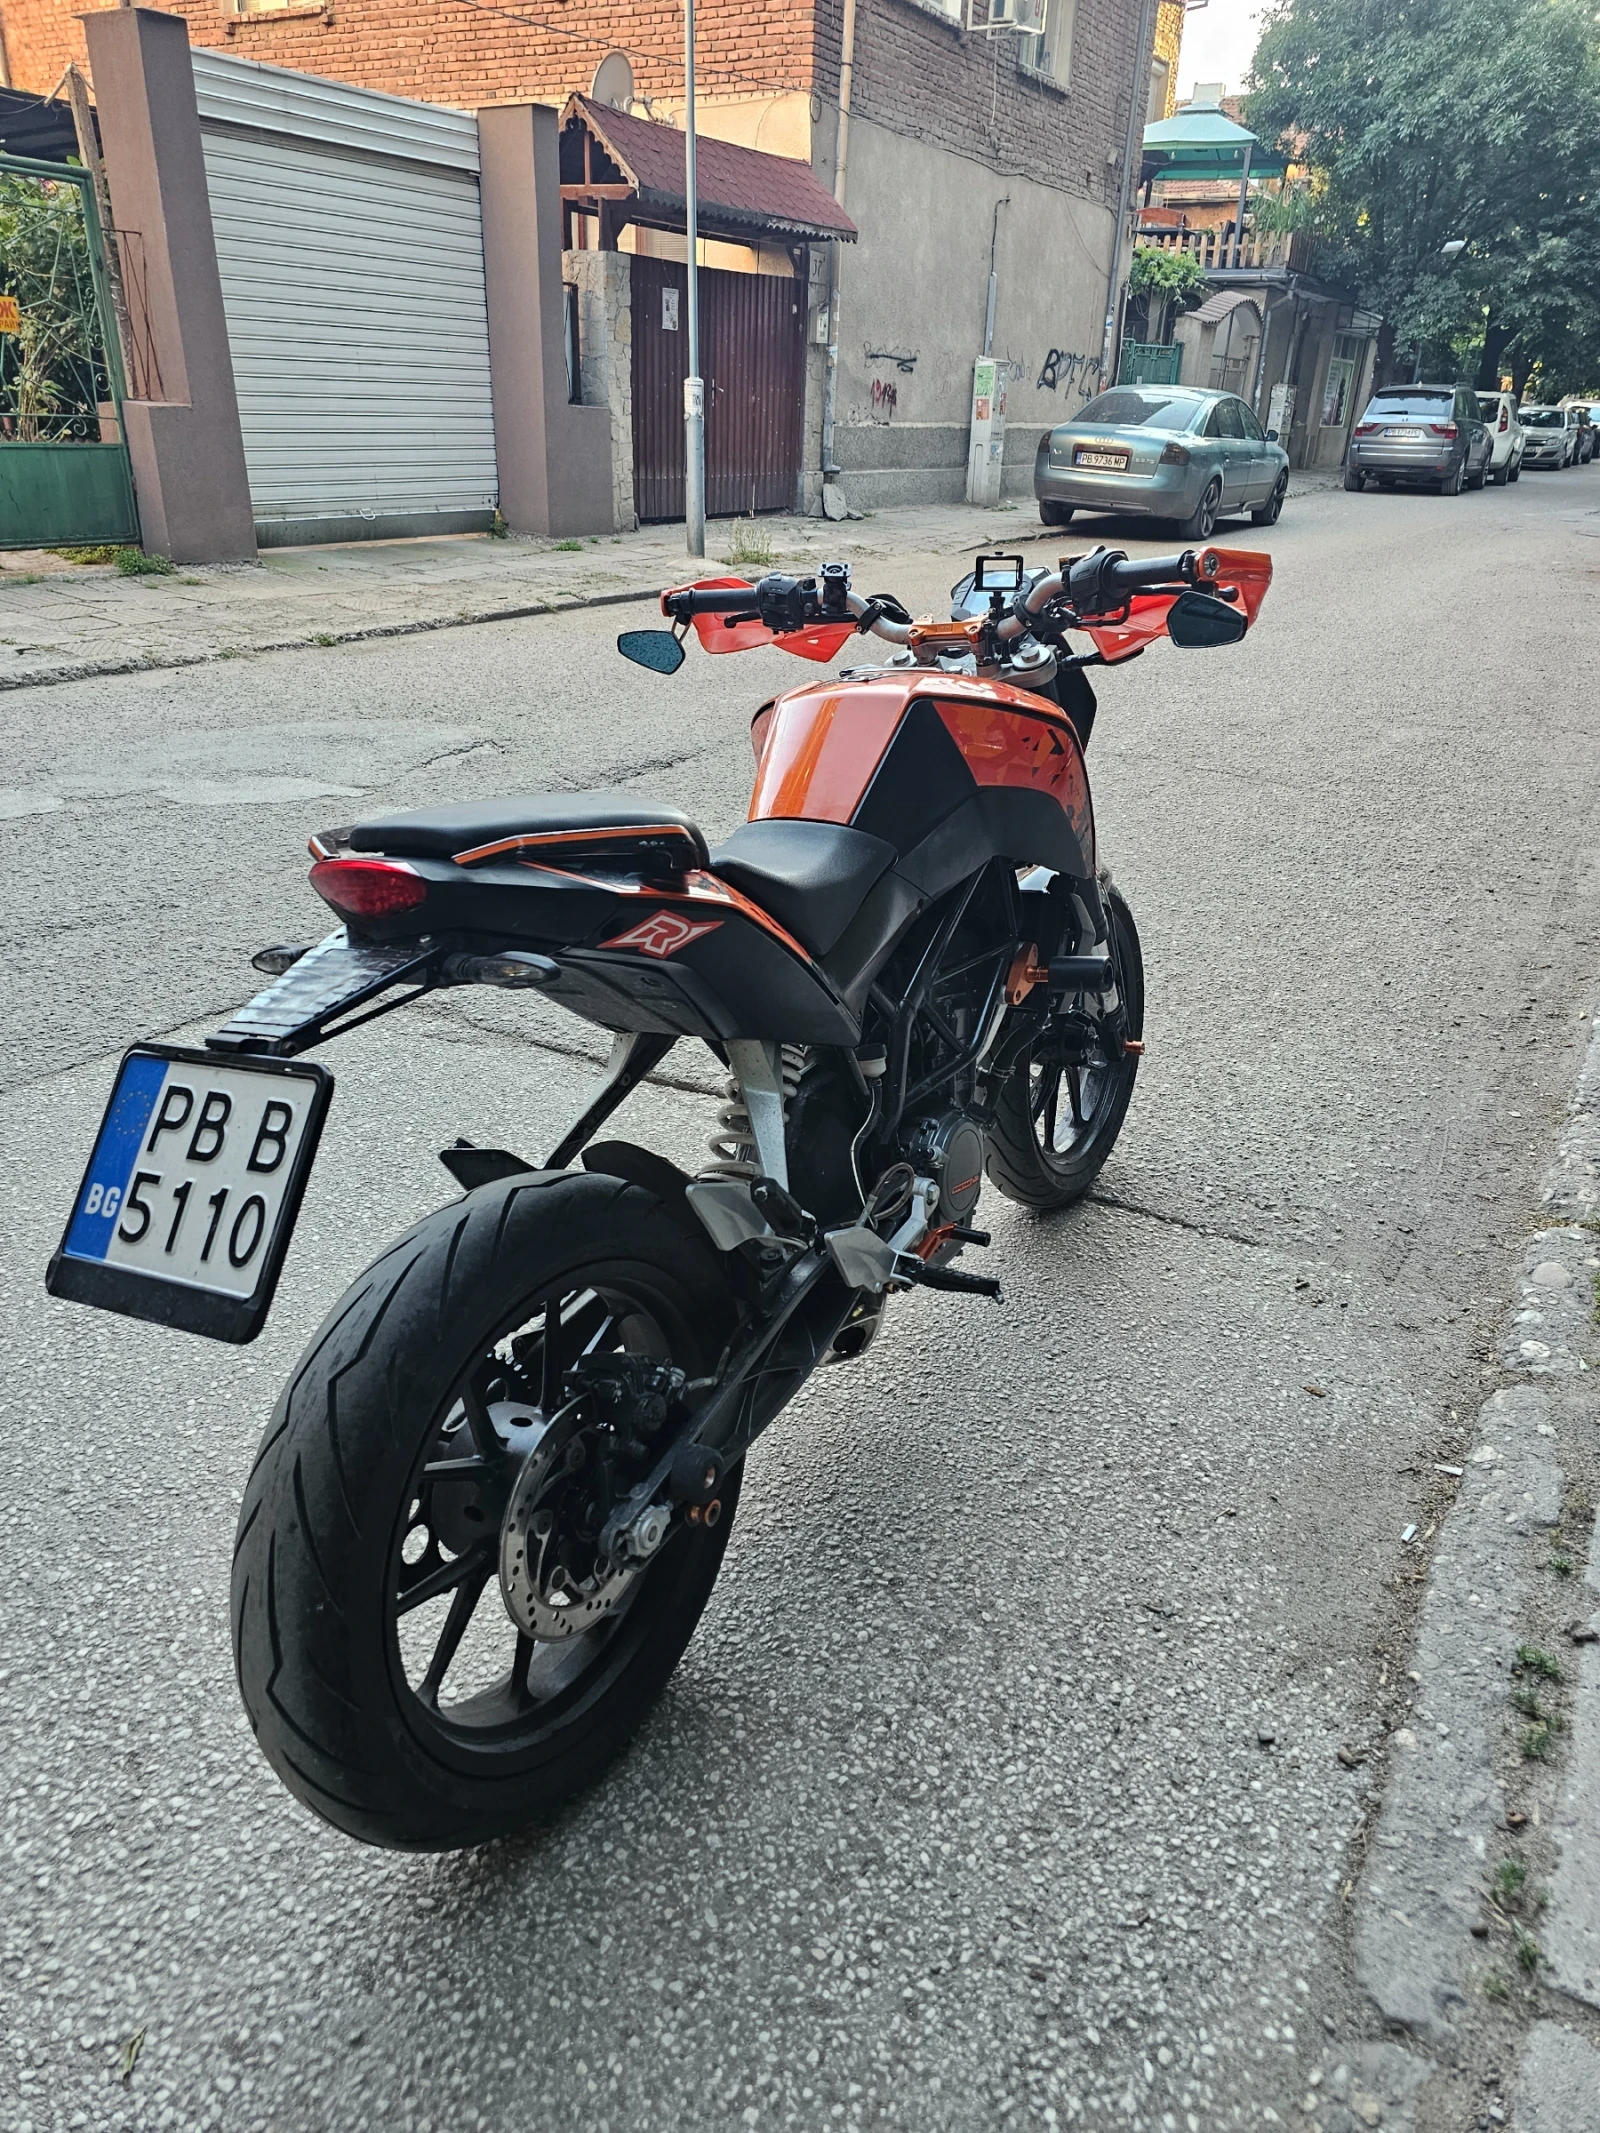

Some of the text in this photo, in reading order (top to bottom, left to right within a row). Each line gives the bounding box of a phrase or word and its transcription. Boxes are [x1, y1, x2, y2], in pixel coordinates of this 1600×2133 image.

[1081, 453, 1093, 464] PB
[1094, 455, 1112, 465] 9736
[1114, 456, 1125, 467] MP
[147, 1085, 293, 1173] PB B
[84, 1183, 121, 1218] BG
[117, 1171, 267, 1268] 5110
